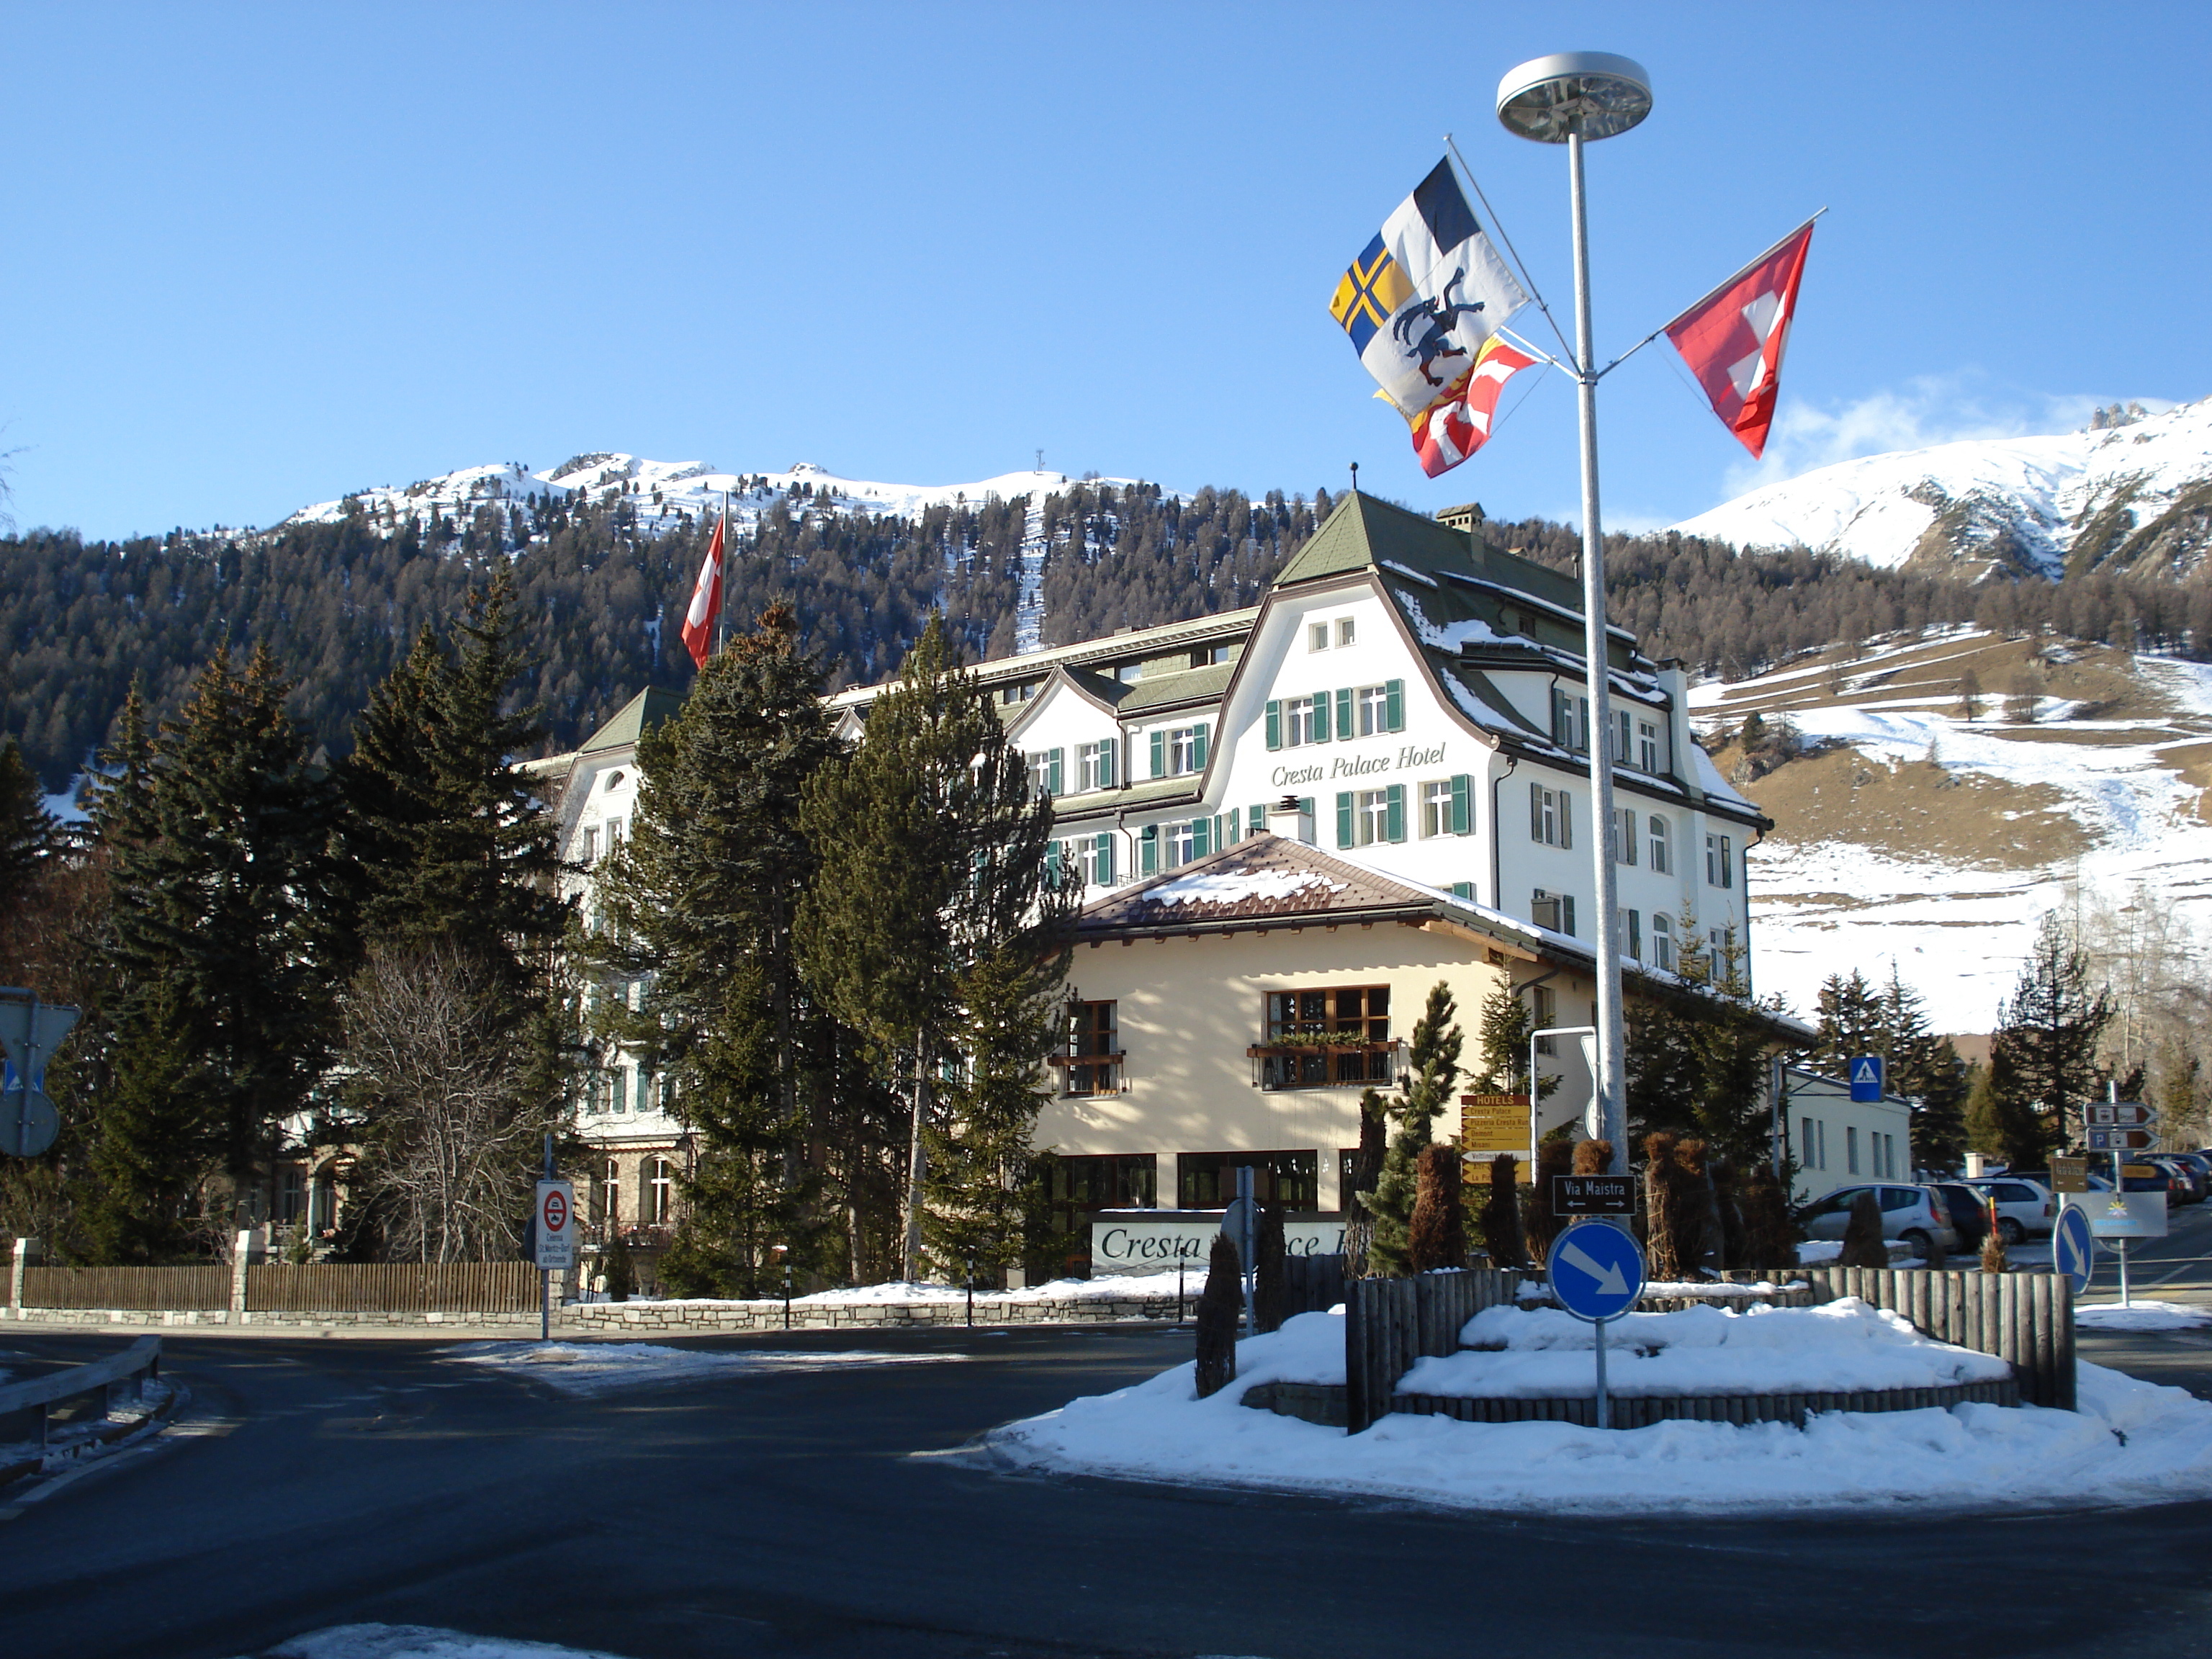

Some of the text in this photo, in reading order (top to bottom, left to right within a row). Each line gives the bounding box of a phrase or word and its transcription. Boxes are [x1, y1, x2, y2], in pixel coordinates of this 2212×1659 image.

[1271, 742, 1446, 787] Cresta Palace Hotel
[1477, 1096, 1514, 1105] HOTELS
[1565, 1181, 1625, 1196] Via Maistra
[1101, 1228, 1202, 1259] Cresta
